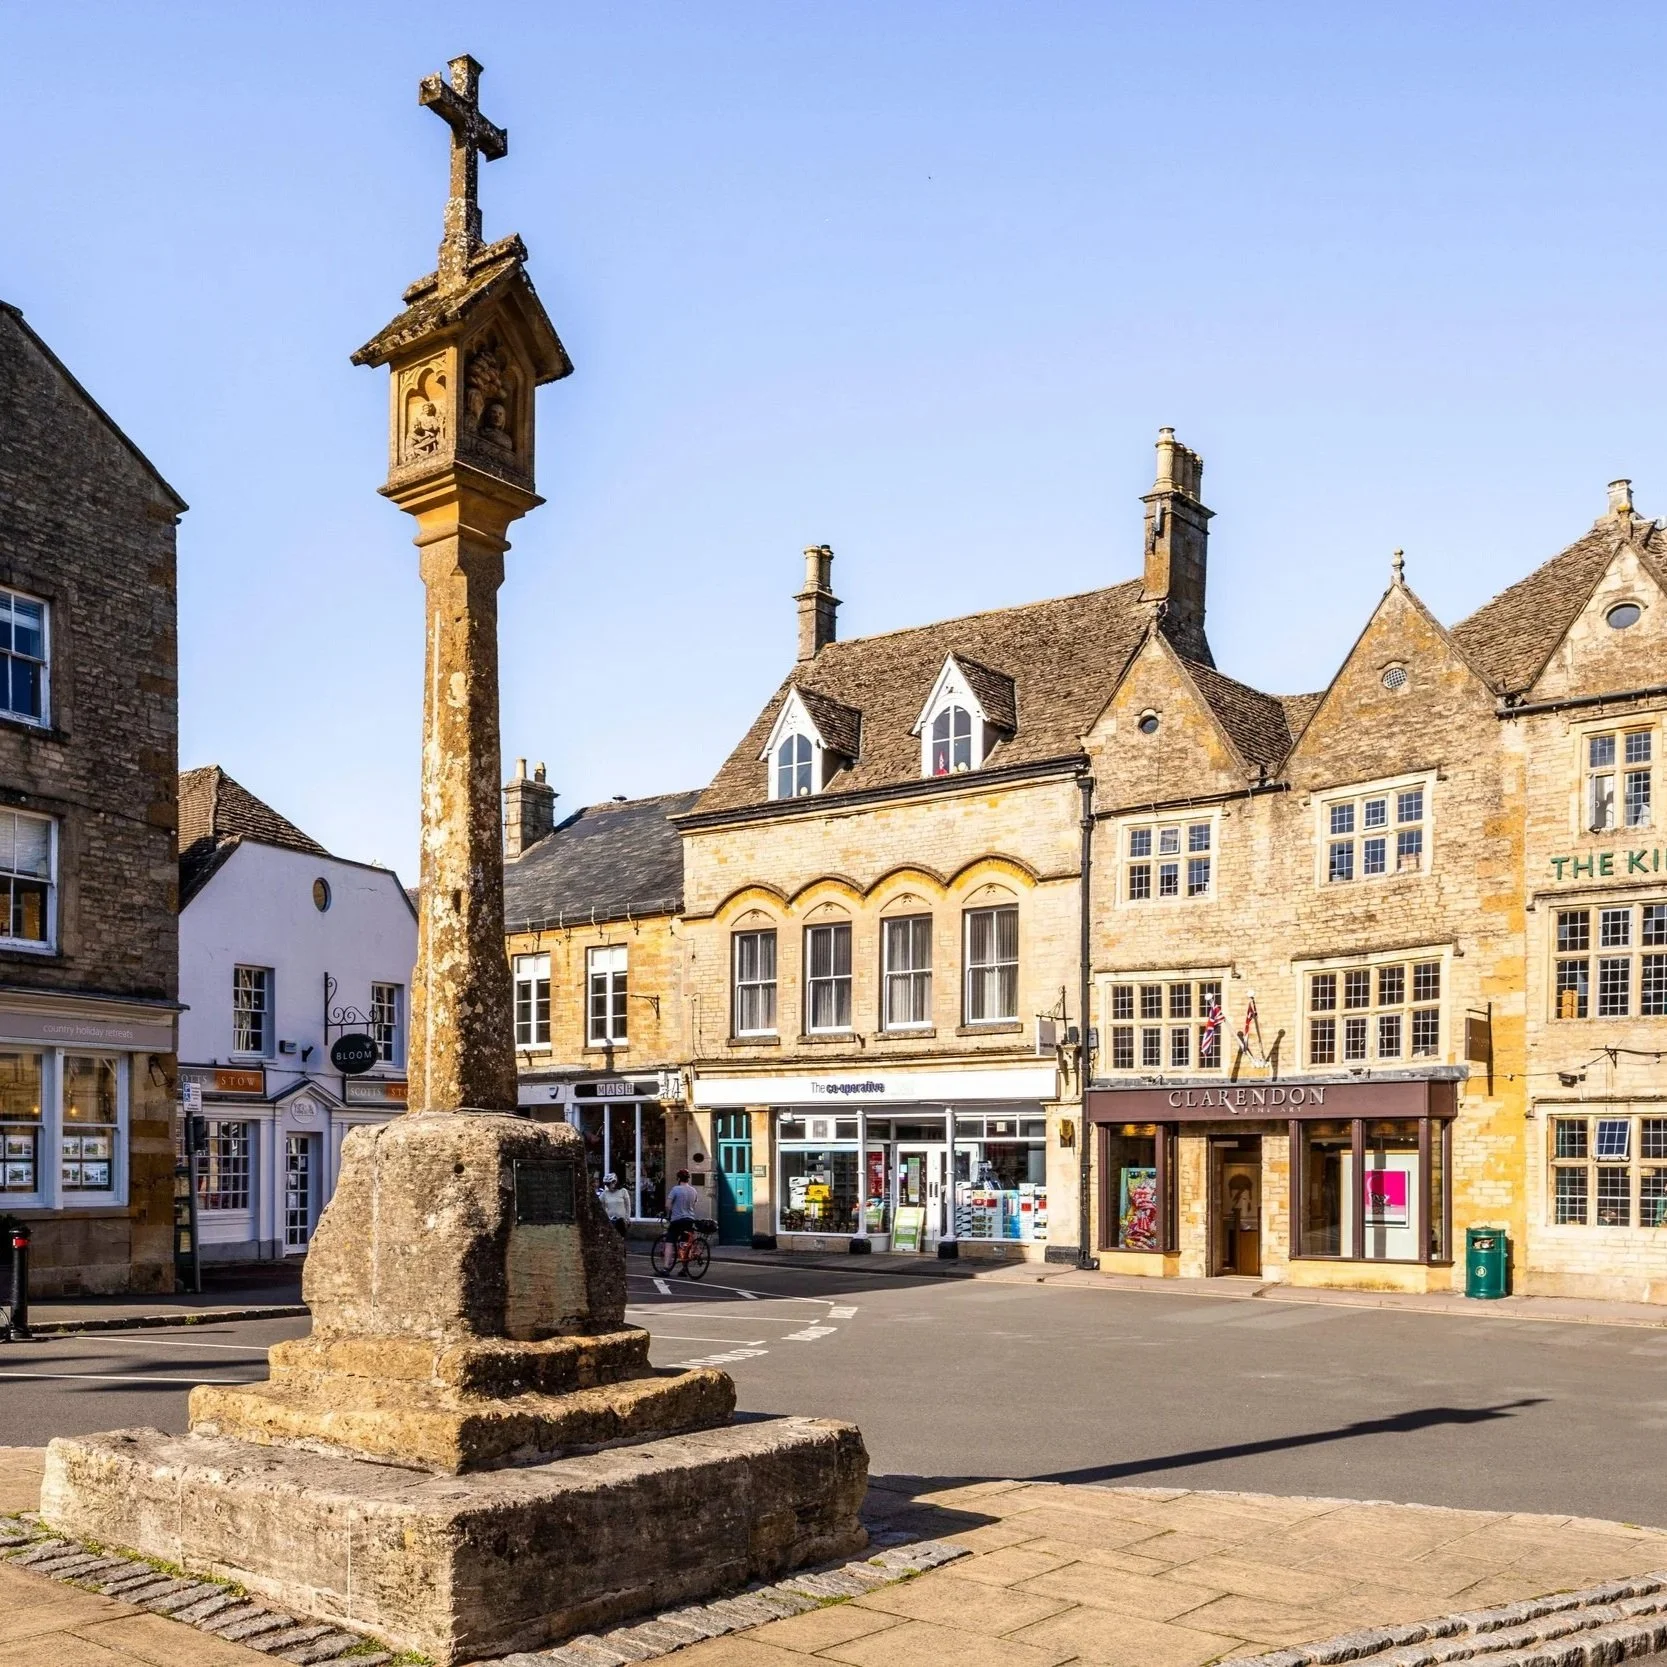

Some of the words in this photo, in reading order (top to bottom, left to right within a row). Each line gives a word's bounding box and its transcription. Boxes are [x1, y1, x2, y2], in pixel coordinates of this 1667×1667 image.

[1550, 853, 1614, 880] THE
[1628, 848, 1667, 874] KI
[43, 1024, 75, 1037] country
[76, 1025, 104, 1038] holiday
[105, 1028, 134, 1039] retreats
[336, 1050, 372, 1061] BLOOM
[221, 1076, 255, 1087] STOW
[597, 1081, 634, 1096] MASH
[811, 1081, 825, 1094] The
[826, 1080, 885, 1096] co-operative
[350, 1087, 381, 1097] SCOTTS
[1168, 1087, 1326, 1115] CLARENDON
[1280, 1106, 1302, 1114] ART
